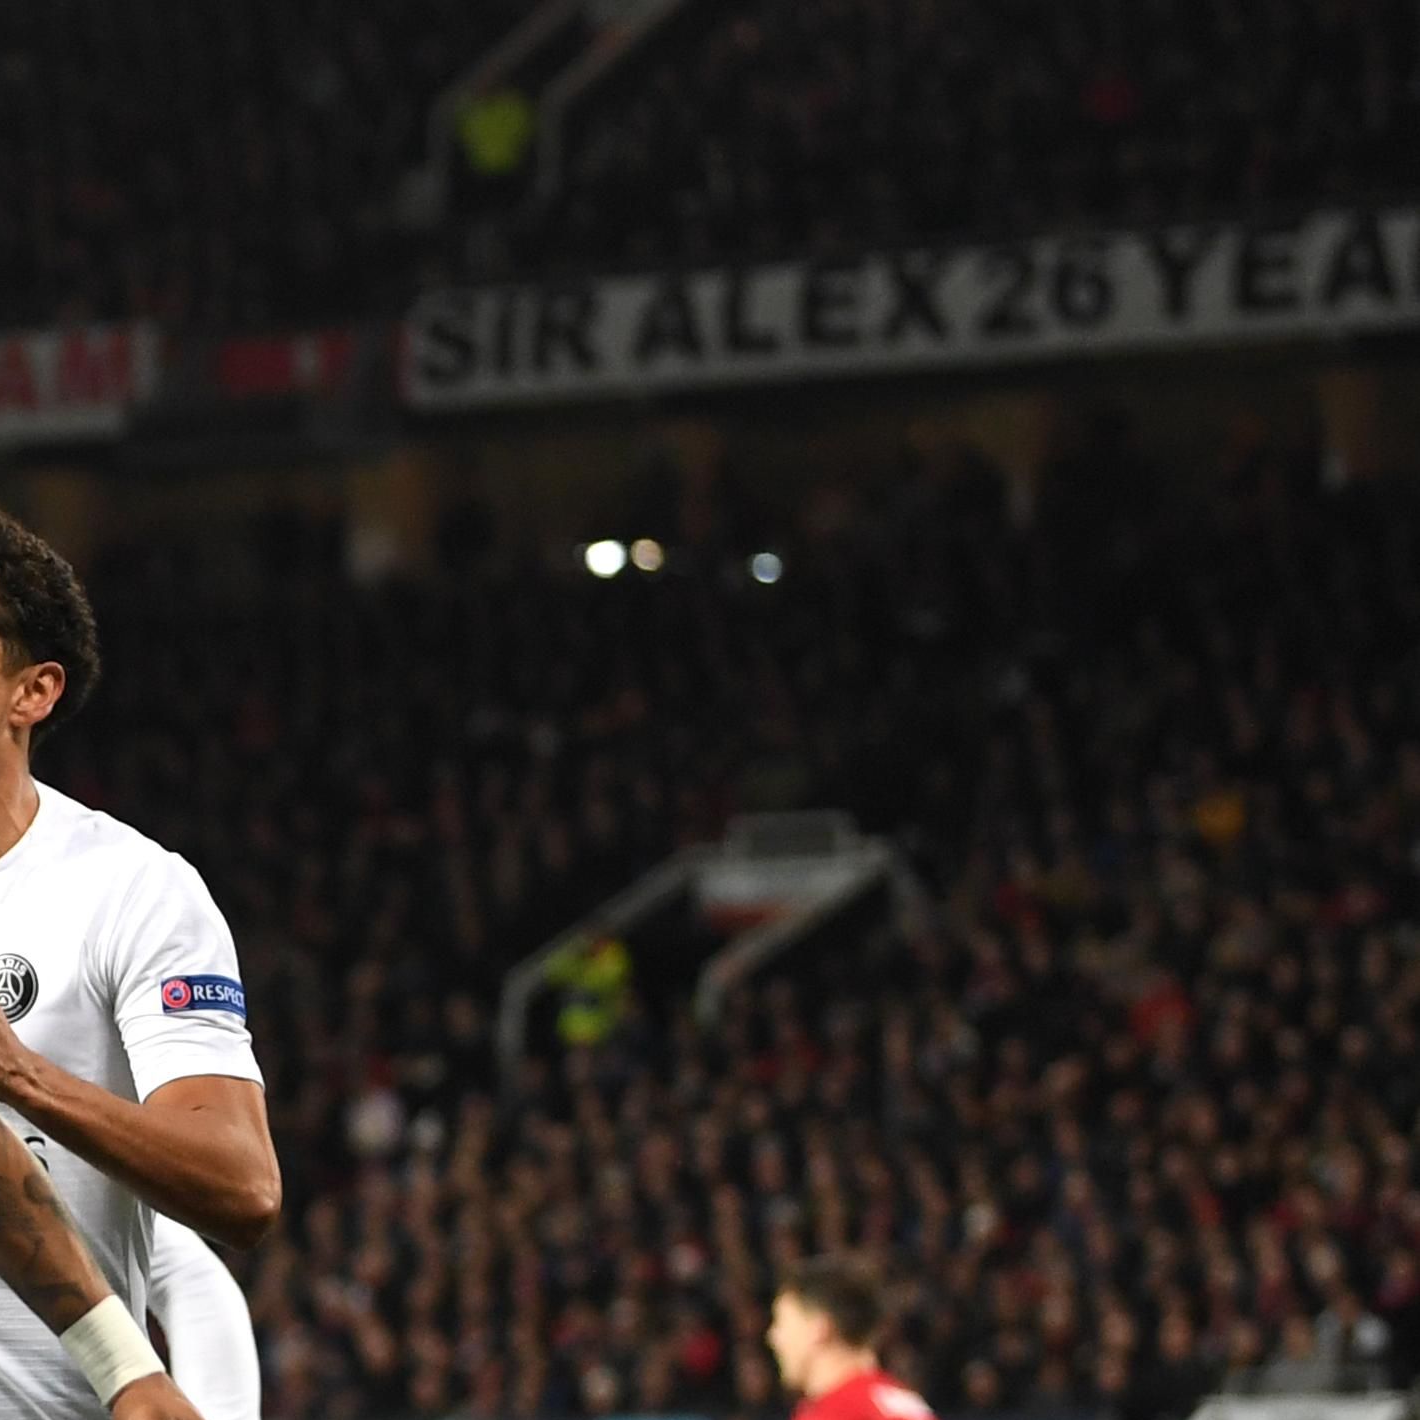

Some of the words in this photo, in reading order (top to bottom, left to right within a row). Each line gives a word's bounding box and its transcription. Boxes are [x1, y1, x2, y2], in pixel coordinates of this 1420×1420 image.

[418, 290, 601, 385] SIR
[628, 255, 951, 368] ALEX
[976, 241, 1117, 338] 26
[1139, 212, 1420, 324] YEA
